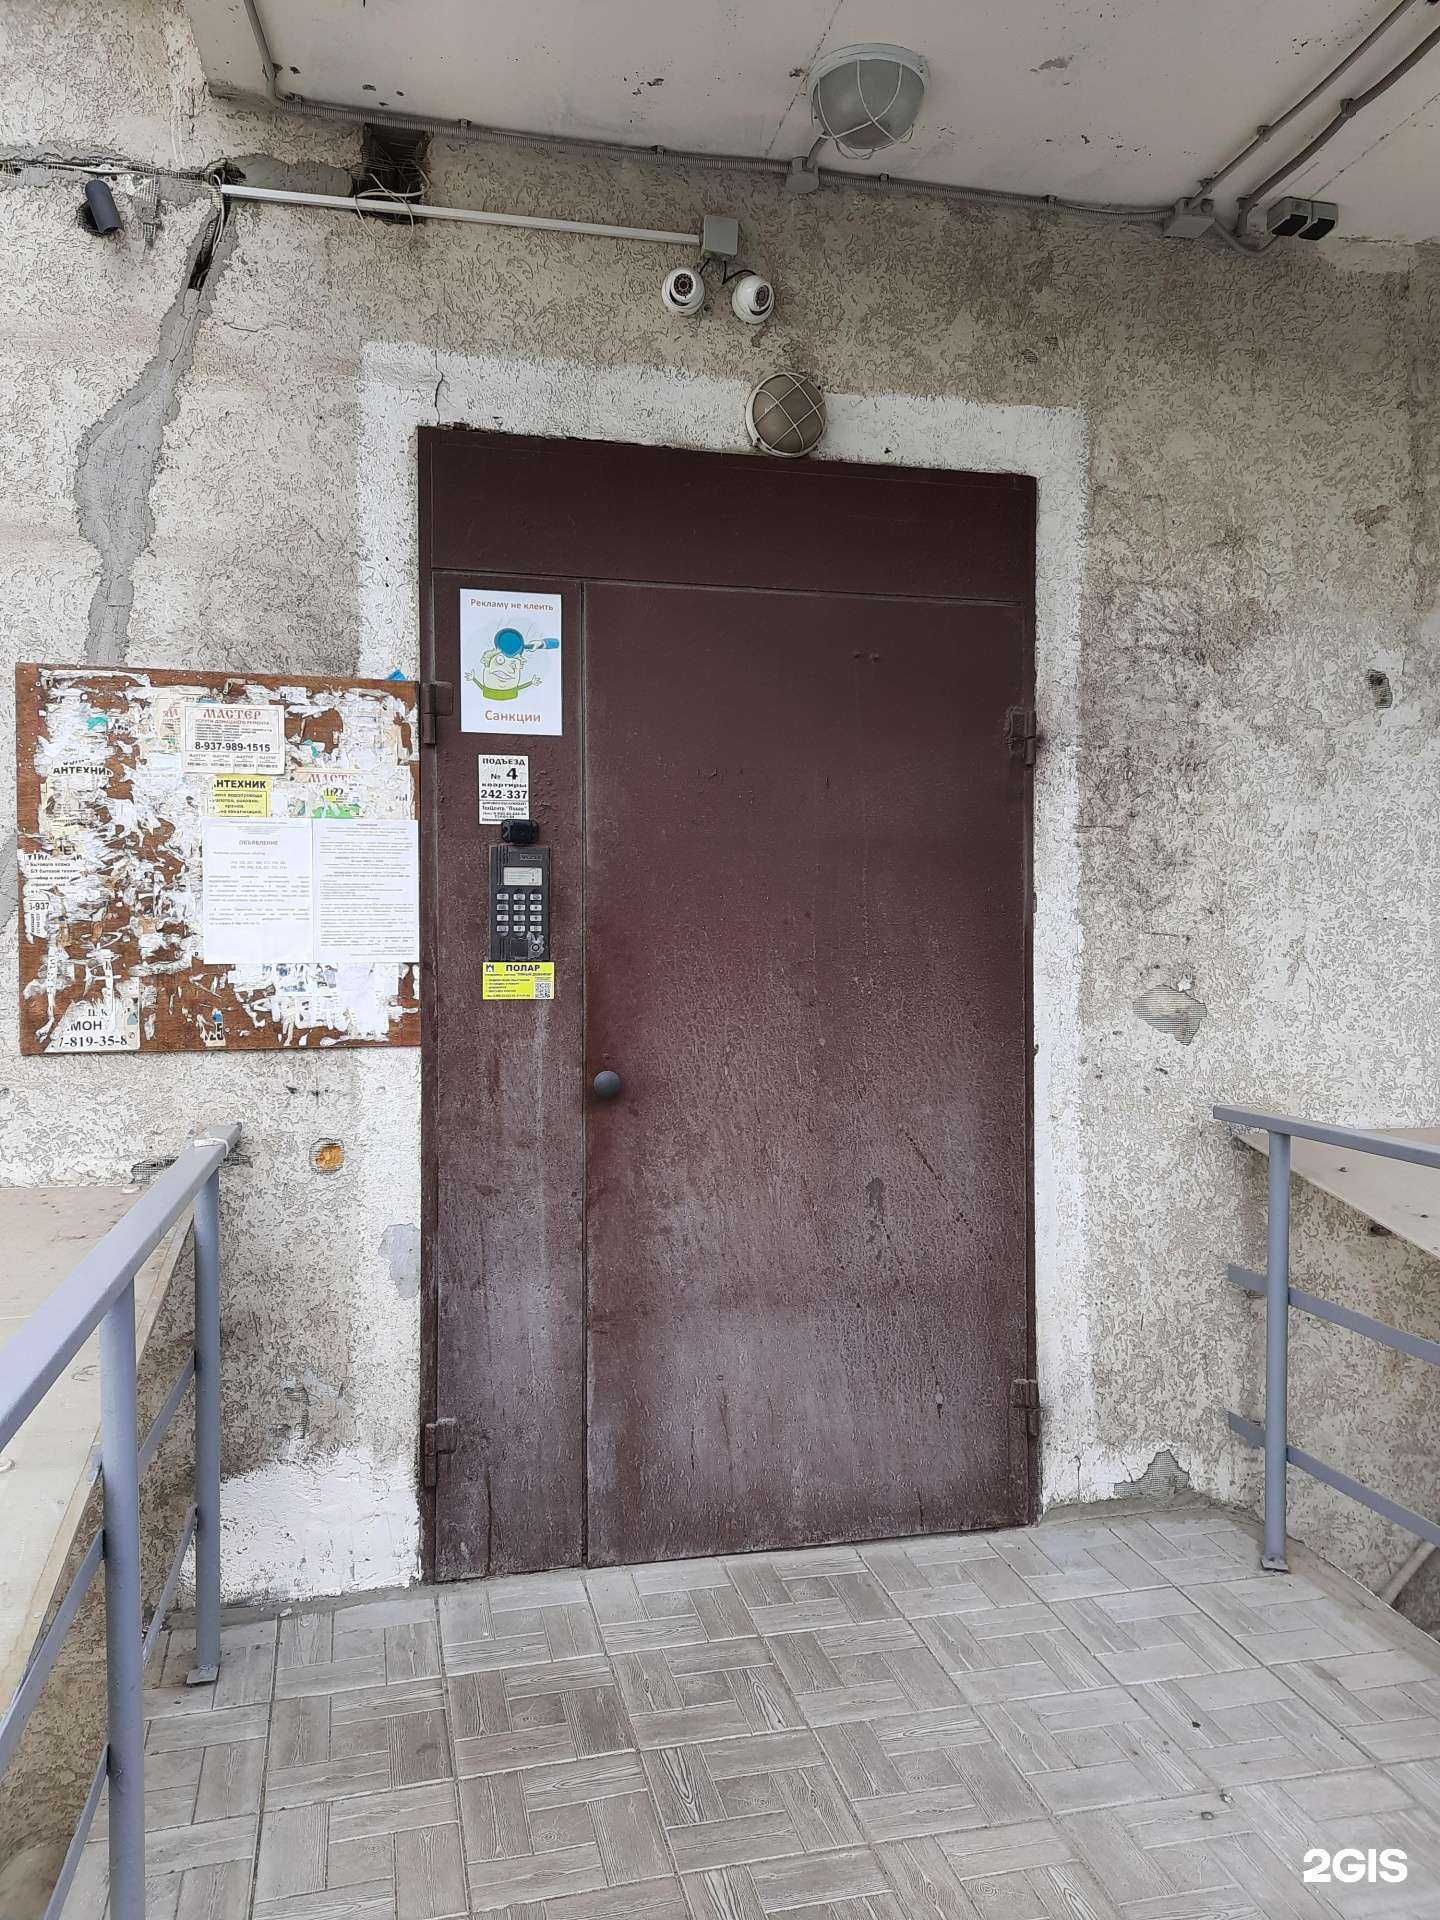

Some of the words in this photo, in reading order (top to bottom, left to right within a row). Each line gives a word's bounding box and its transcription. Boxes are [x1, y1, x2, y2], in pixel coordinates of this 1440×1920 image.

[470, 598, 509, 611] Рекламу
[510, 602, 522, 610] не
[523, 603, 554, 612] клеить
[203, 708, 262, 720] МАСТЕР
[484, 710, 541, 724] Санкции
[194, 741, 271, 753] 8-937-989-1515
[482, 757, 526, 766] ПОДЪЕЗД
[506, 767, 519, 780] 4
[213, 779, 266, 789] НТЕХНИК
[480, 789, 528, 800] 242-337
[505, 964, 541, 972] ПОЛАР
